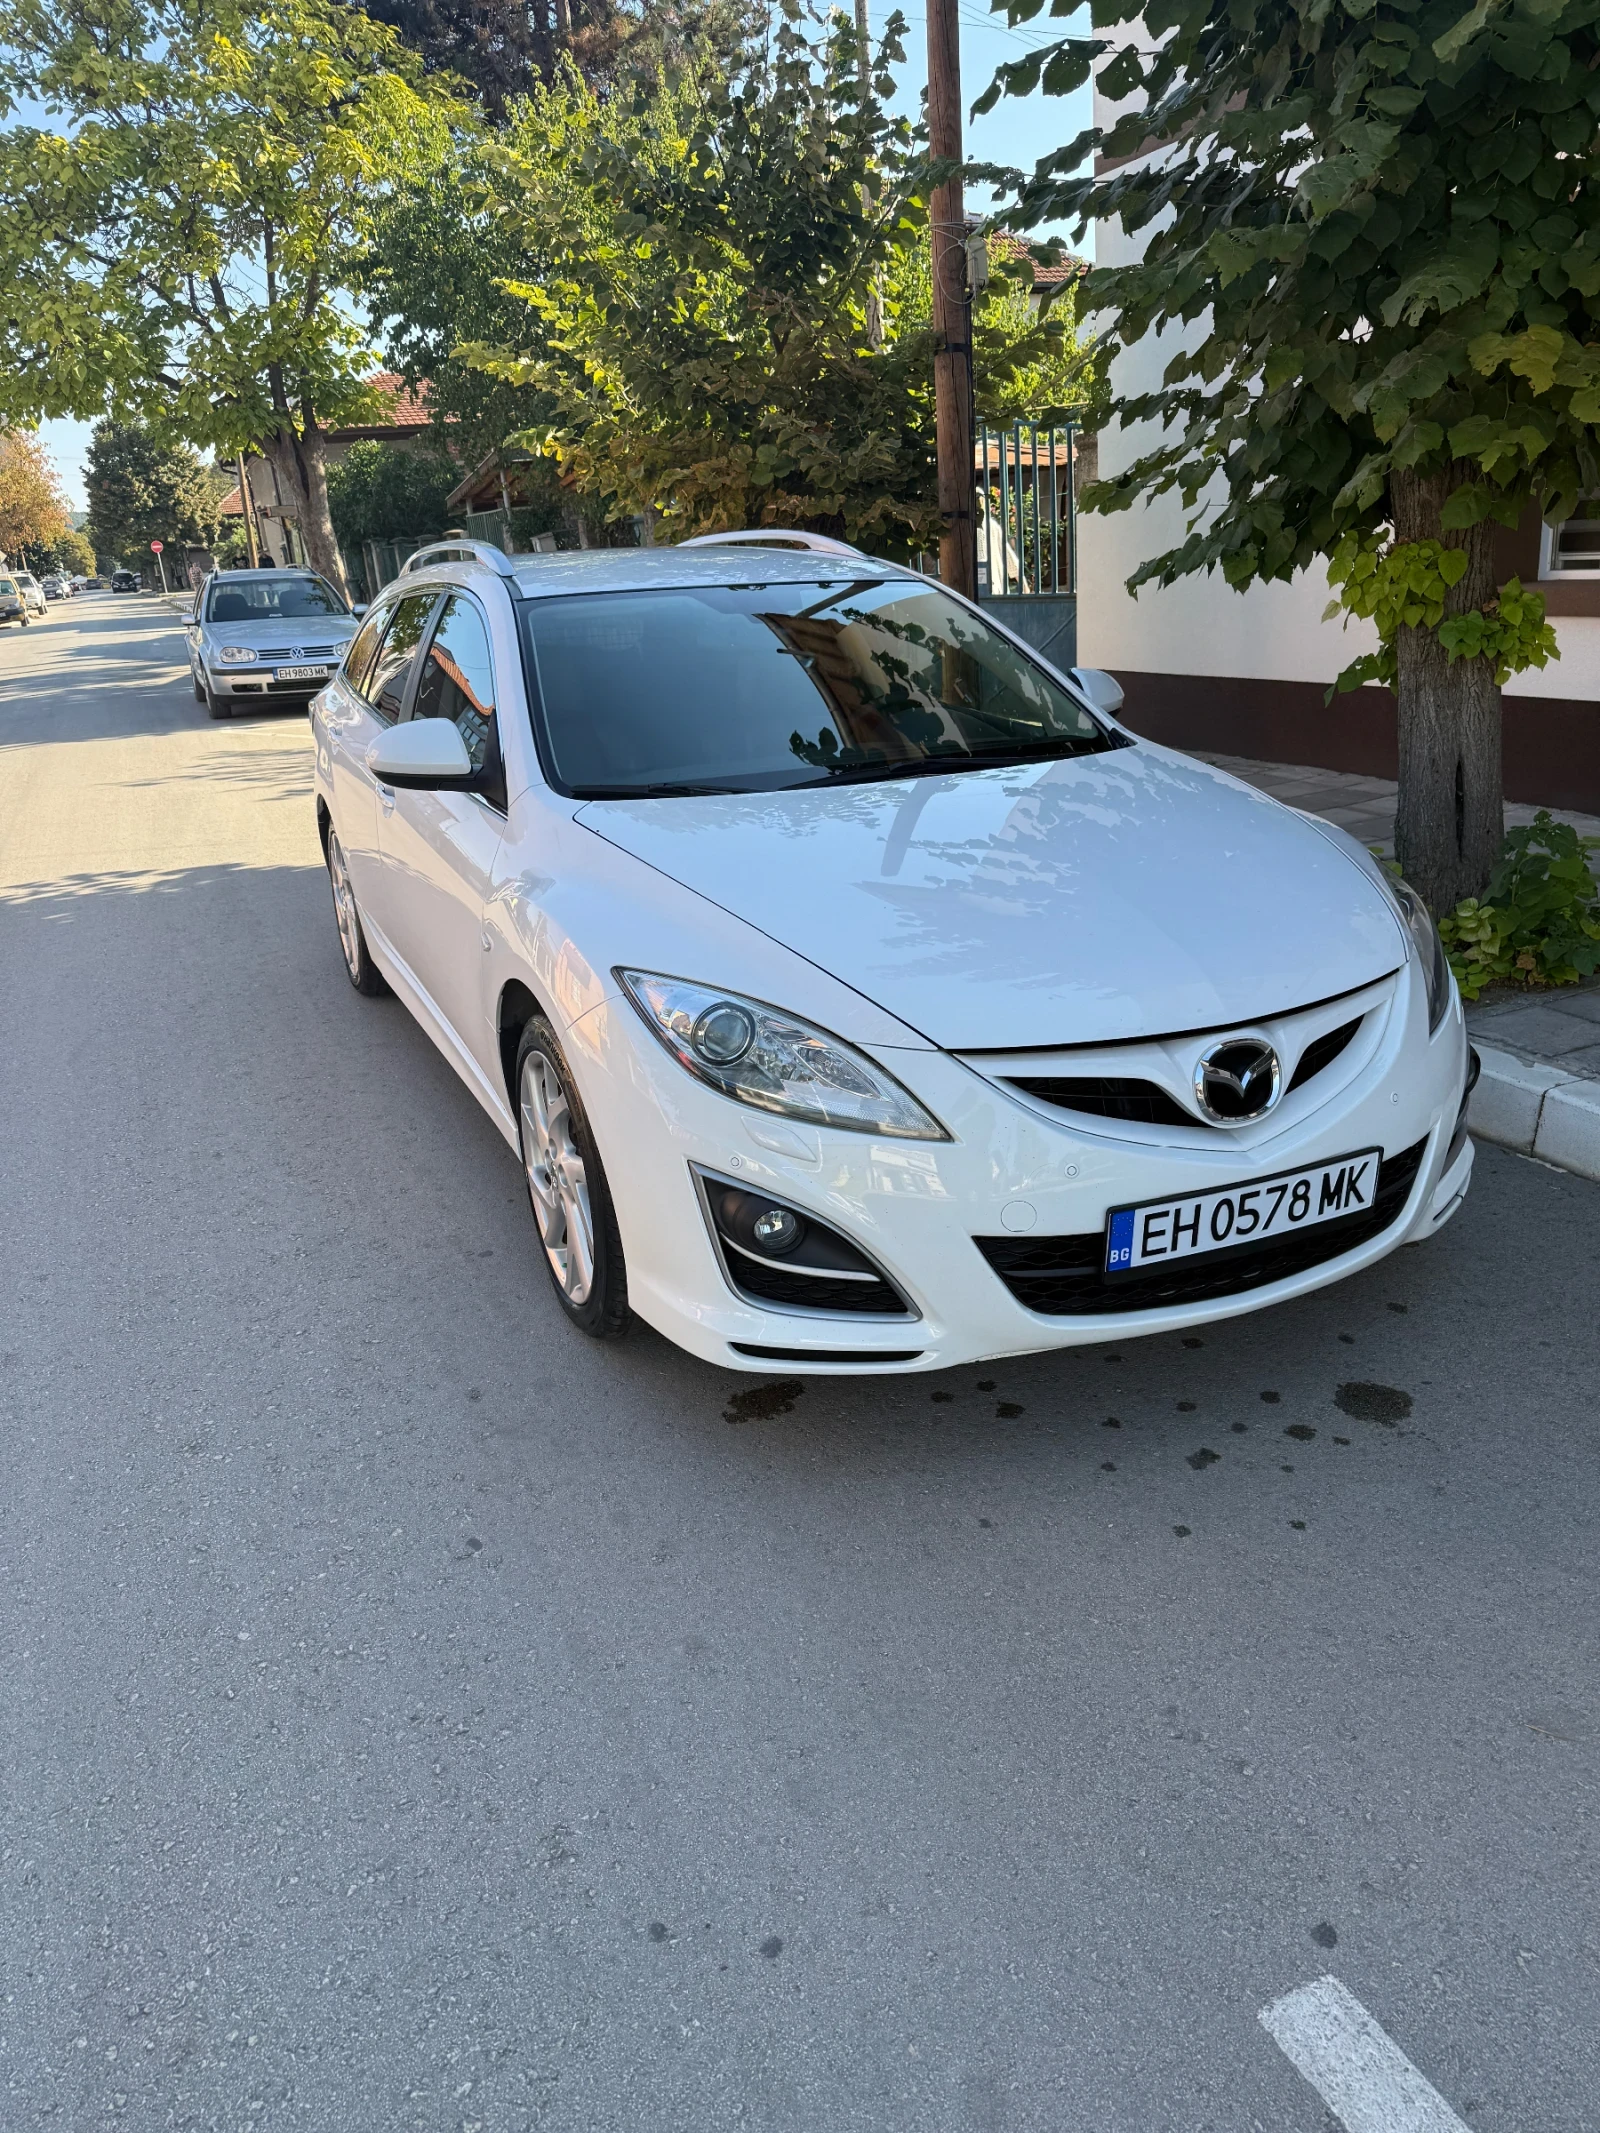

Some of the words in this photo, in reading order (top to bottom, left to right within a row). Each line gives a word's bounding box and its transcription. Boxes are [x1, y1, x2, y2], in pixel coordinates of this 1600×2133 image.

[279, 669, 292, 679] EH
[292, 667, 314, 678] 9803
[314, 666, 327, 676] MK
[1141, 1204, 1201, 1258] EH
[1210, 1179, 1311, 1242] 0578
[1317, 1161, 1370, 1217] MK
[1109, 1247, 1130, 1264] BG
